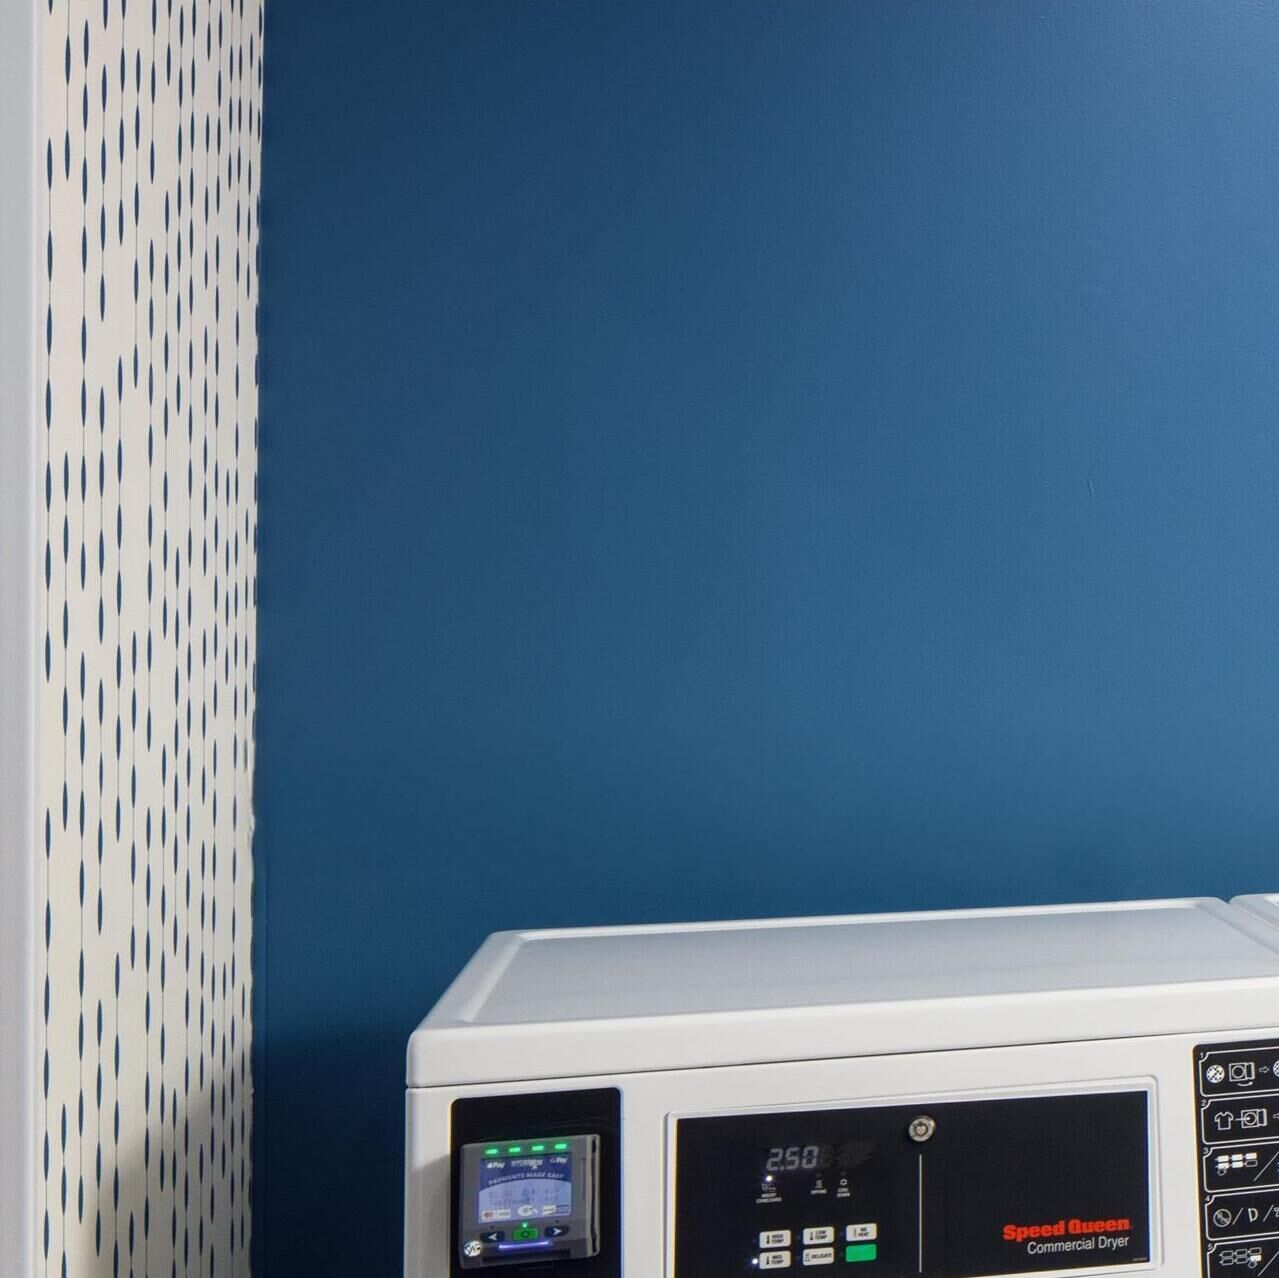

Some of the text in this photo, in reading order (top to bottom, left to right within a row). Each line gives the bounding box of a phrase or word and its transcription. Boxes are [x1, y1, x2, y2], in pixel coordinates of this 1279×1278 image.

[1003, 1218, 1131, 1242] Speed Queen
[1027, 1236, 1130, 1254] Commercial Dryer
